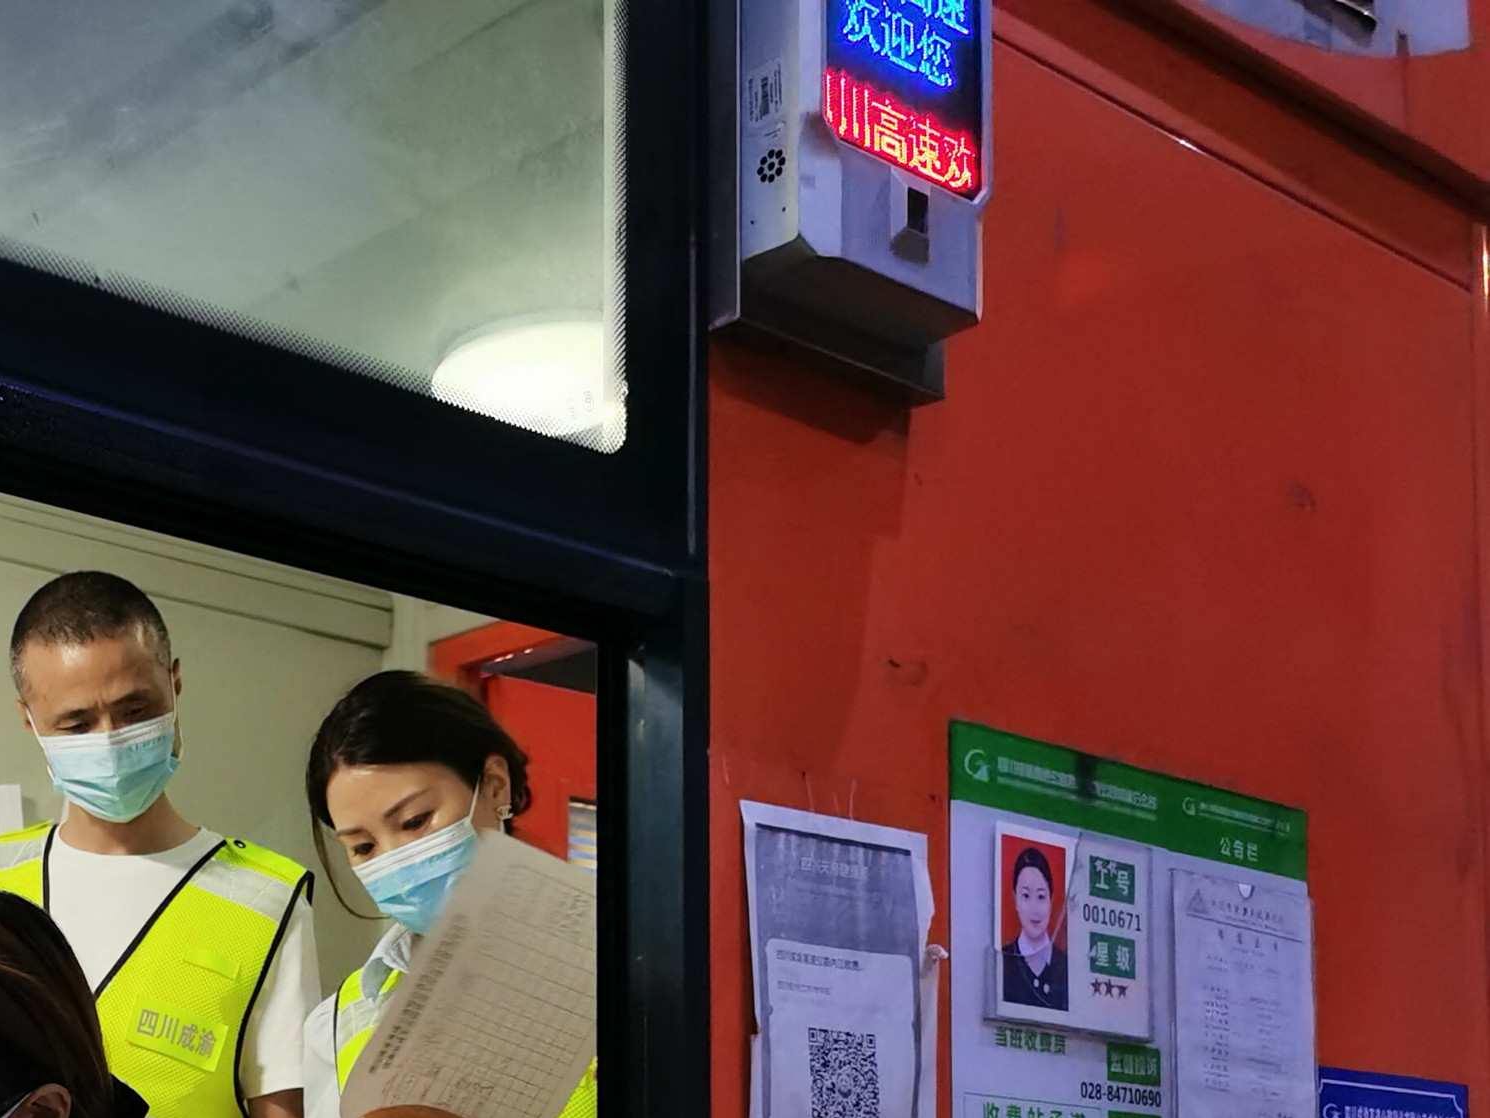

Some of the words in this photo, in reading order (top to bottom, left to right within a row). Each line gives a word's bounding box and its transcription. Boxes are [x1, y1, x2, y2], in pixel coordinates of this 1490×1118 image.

[843, 0, 952, 87] 欢迎您
[825, 72, 975, 188] 川高速欢
[1219, 837, 1258, 862] 公告栏
[1082, 903, 1142, 932] 0010671
[1095, 941, 1131, 972] 星级
[136, 1008, 217, 1059] 四川成渝
[995, 1026, 1066, 1056] 当班收费员
[1080, 1082, 1162, 1108] 028-84710690
